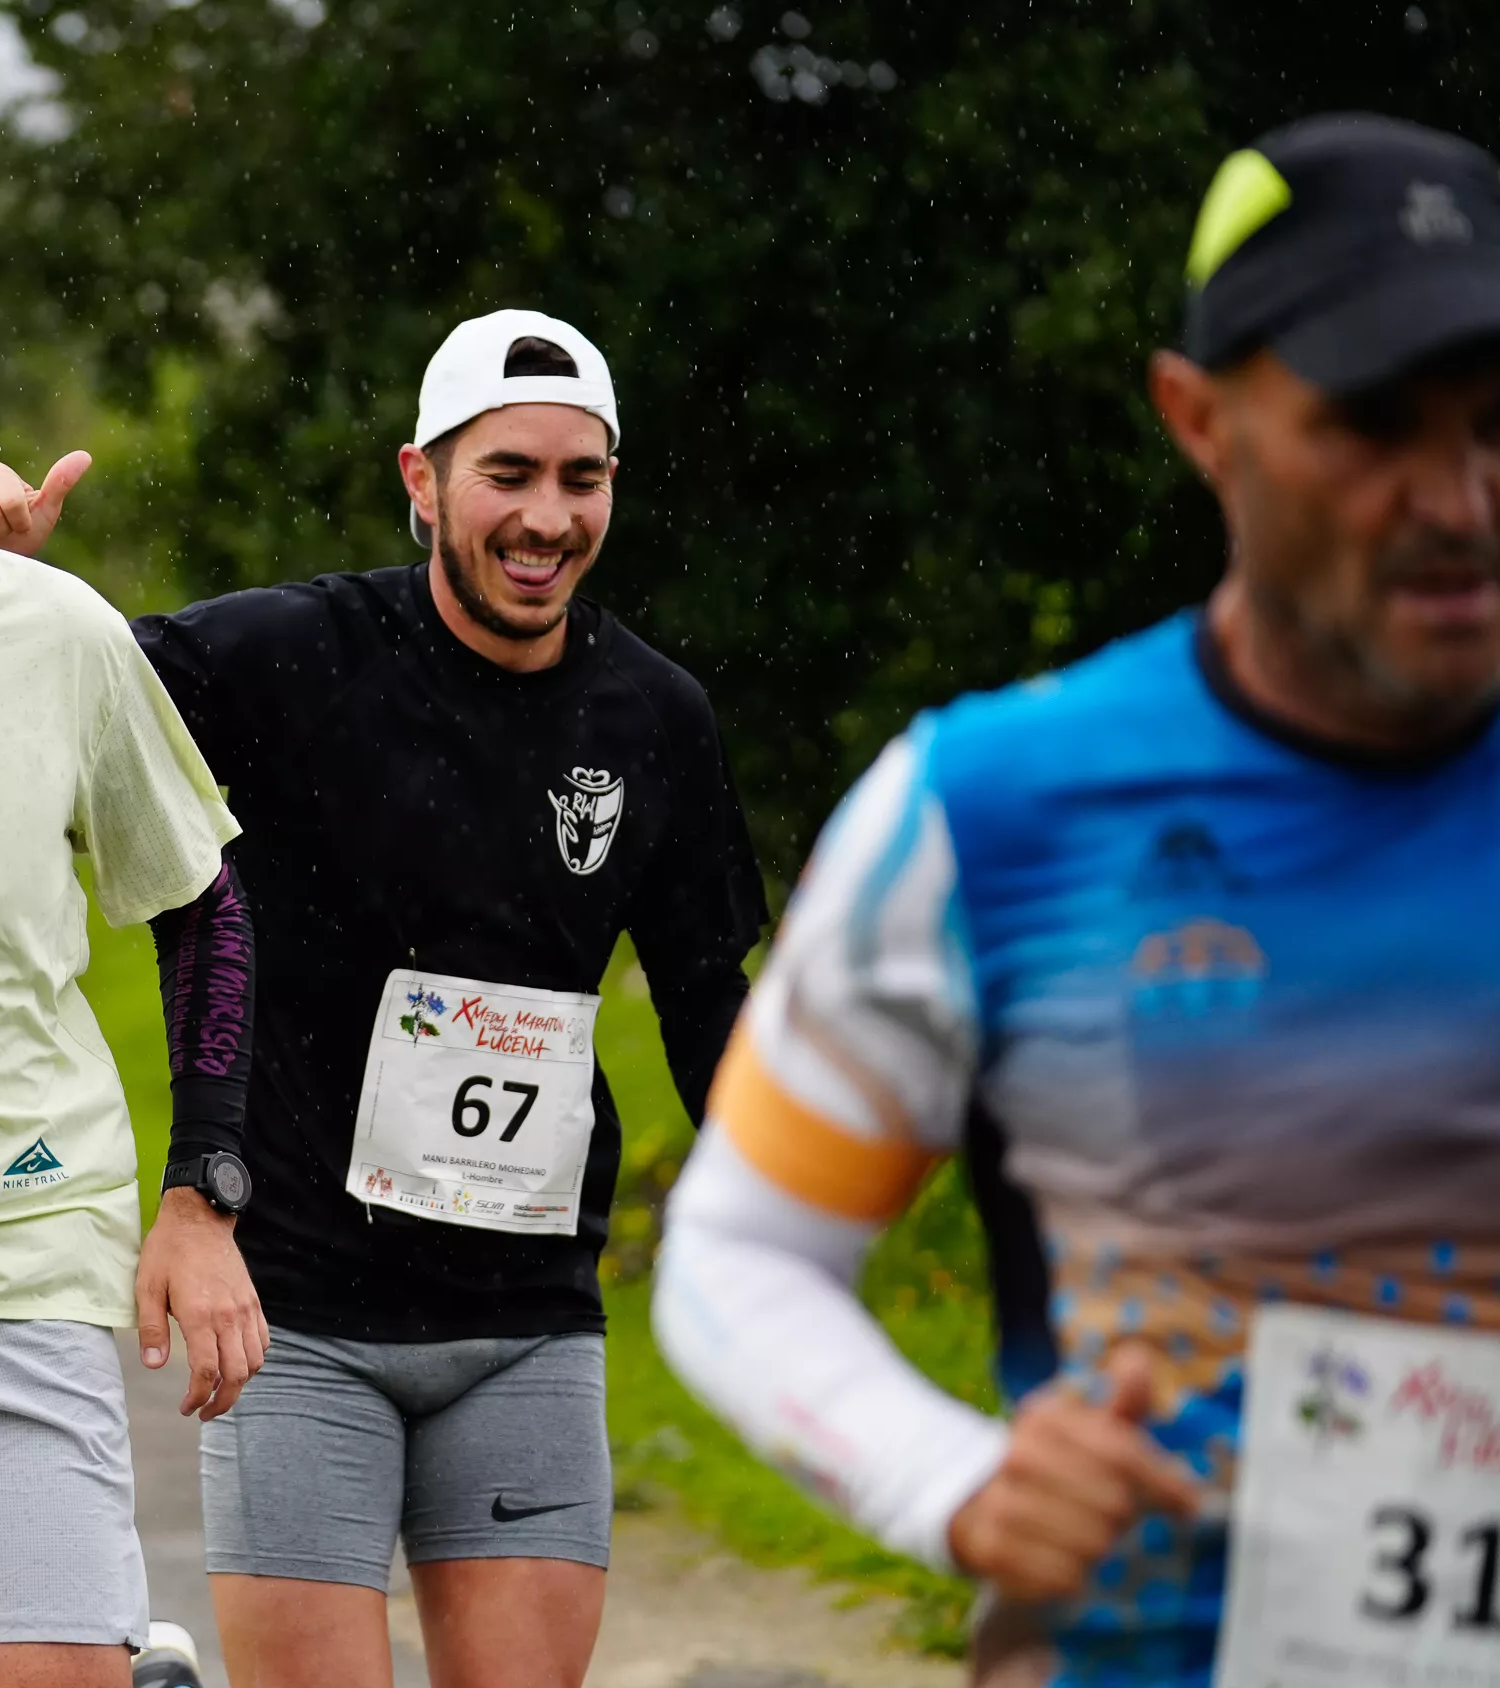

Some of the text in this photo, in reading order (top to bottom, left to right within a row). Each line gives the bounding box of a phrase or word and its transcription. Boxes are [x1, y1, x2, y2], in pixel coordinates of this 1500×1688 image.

[475, 1025, 552, 1058] LUCENA
[452, 1075, 539, 1142] 67
[422, 1153, 547, 1177] MANU BARRILERO MOHEDANO
[3, 1171, 70, 1189] NIKE TRAIL
